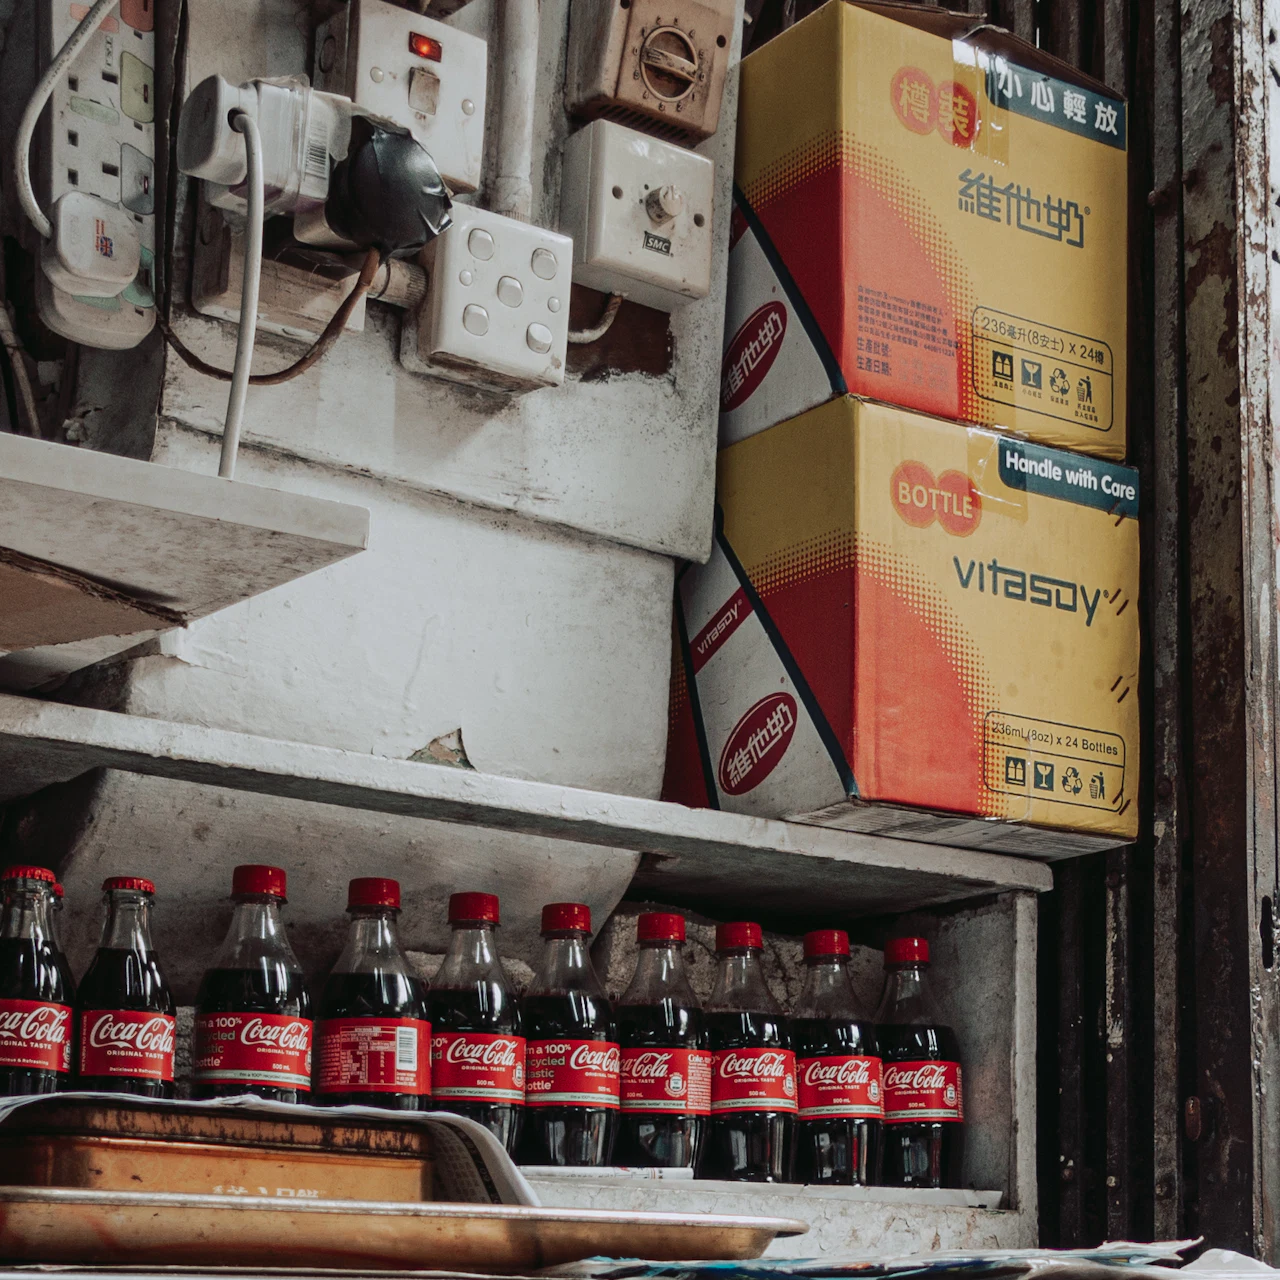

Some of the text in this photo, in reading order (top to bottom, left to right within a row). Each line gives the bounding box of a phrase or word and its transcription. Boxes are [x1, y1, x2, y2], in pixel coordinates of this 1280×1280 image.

[898, 76, 971, 139] 樽裝
[997, 68, 1119, 136] 小心輕放
[647, 237, 669, 252] SMC
[1005, 449, 1136, 502] Handle with Care
[897, 480, 974, 520] BOTTLE
[952, 555, 1102, 627] vitasoy
[696, 601, 739, 655] vitasoy
[1065, 735, 1078, 748] 24
[1081, 738, 1119, 756] Bottles
[215, 1017, 242, 1028] 100%
[240, 1017, 310, 1051] Coca-Cola
[29, 1041, 53, 1051] TASTE
[106, 1049, 165, 1061] ORIGINAL TASTE
[256, 1047, 300, 1057] ORIGINAL TASTE
[446, 1037, 518, 1067] Coca-Cola
[544, 1044, 572, 1054] 100%
[720, 1052, 787, 1078] Coca-Cola
[805, 1060, 871, 1086] Coca-Cola
[882, 1064, 948, 1091] Coca-Cola
